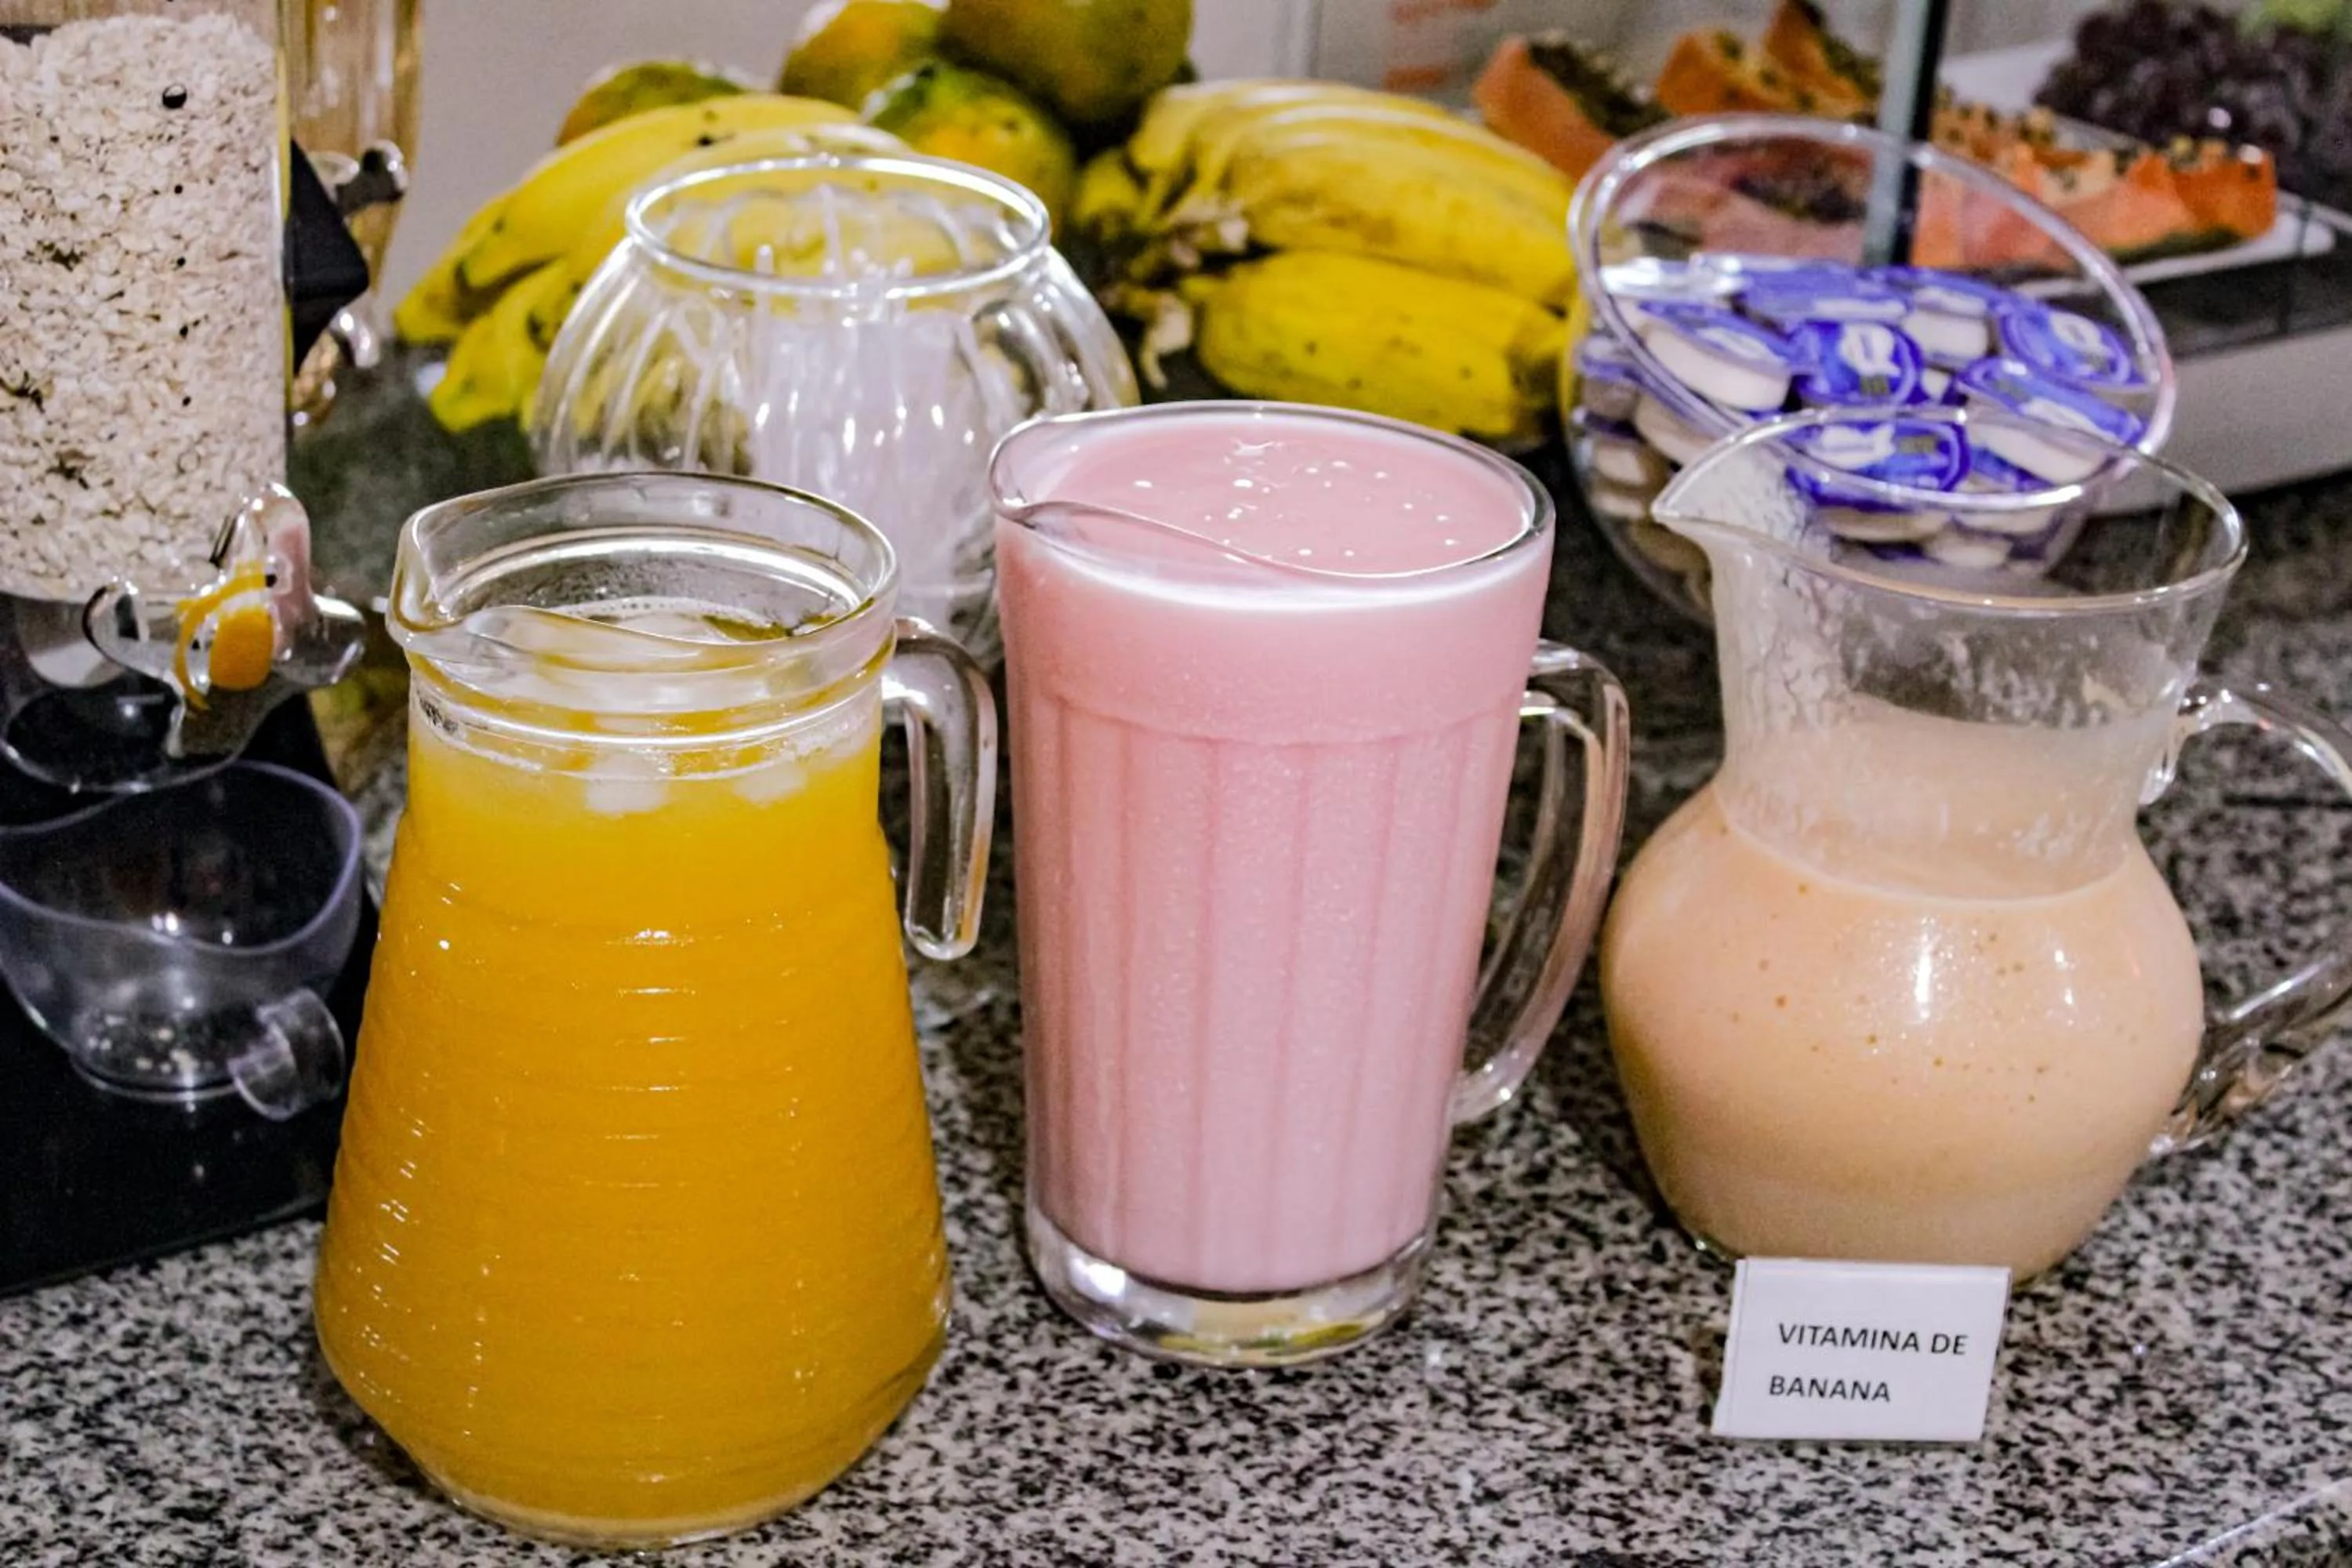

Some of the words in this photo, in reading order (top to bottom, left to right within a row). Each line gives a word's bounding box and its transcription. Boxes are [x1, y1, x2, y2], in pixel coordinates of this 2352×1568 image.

[1778, 1323, 1920, 1352] VITAMINA
[1930, 1333, 1969, 1355] DE
[1769, 1374, 1891, 1403] BANANA
